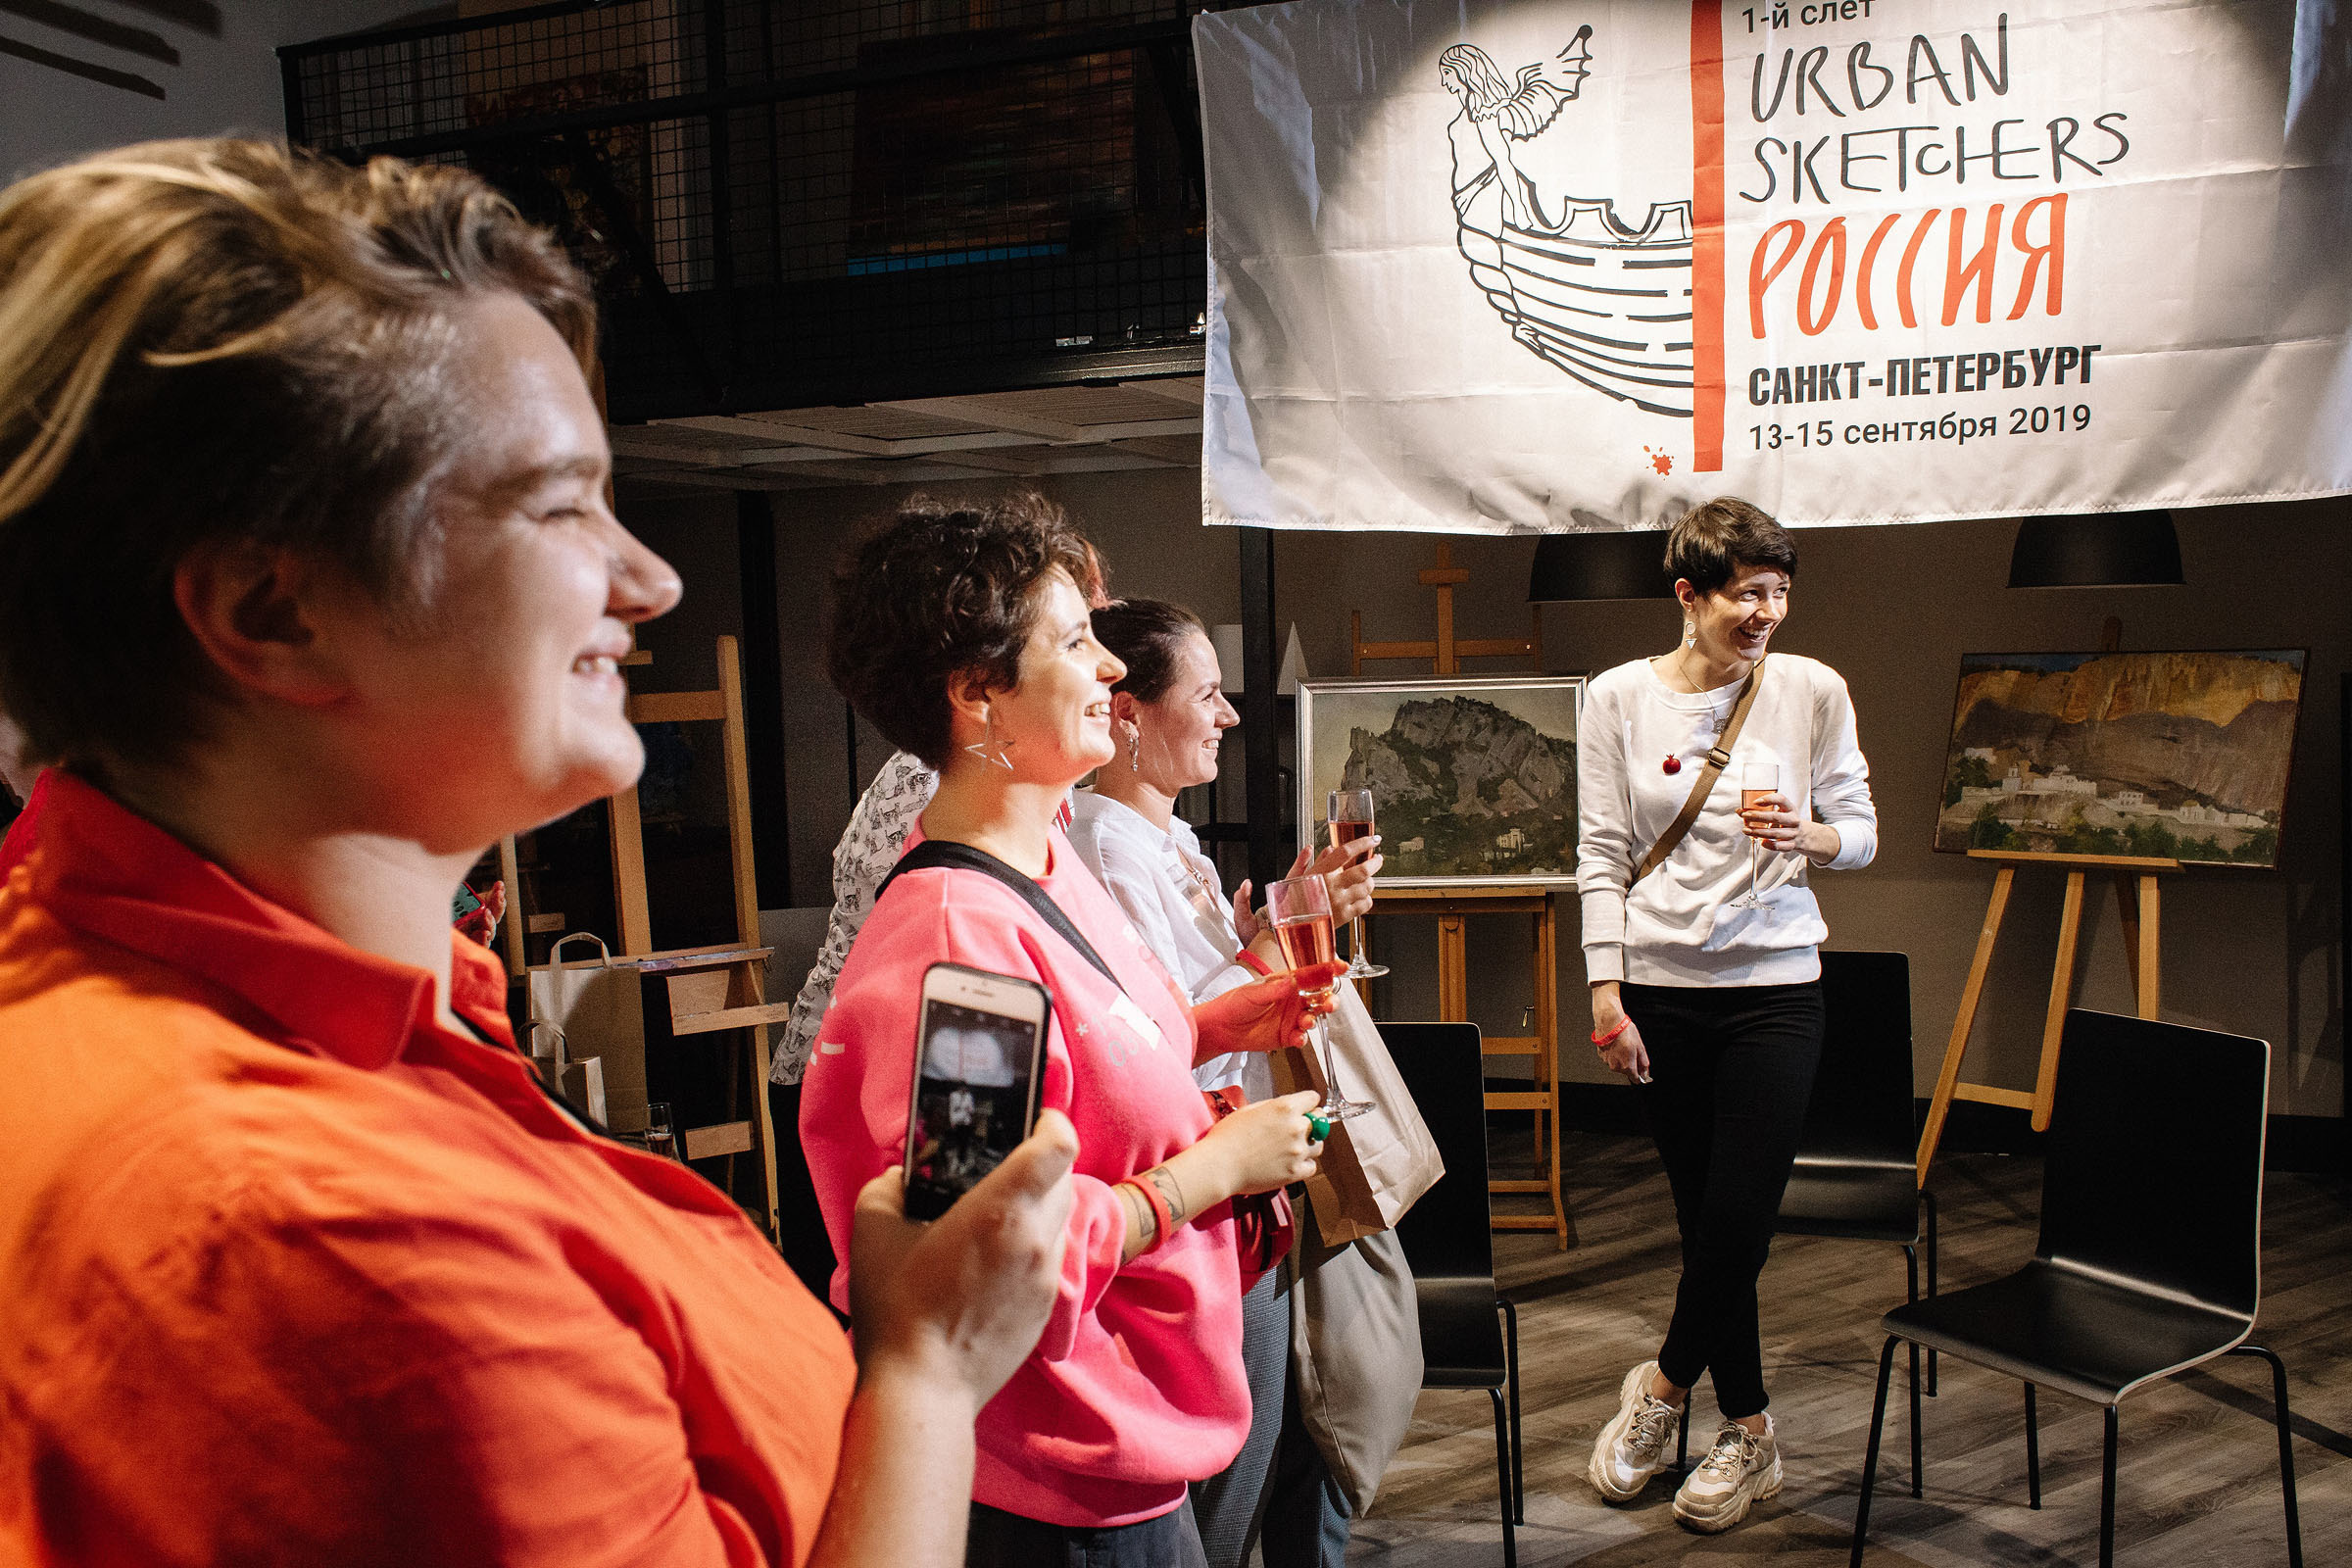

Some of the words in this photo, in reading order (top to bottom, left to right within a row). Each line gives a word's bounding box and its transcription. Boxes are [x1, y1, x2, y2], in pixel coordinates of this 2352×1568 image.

[1741, 2, 1789, 34] 1-й
[1800, 0, 1877, 25] слет
[1751, 12, 2009, 123] URBAN
[1739, 112, 2130, 205] SKETCHERS
[1748, 192, 2069, 340] РОССИЯ
[1748, 344, 2102, 407] САНКТ-ПЕТЕРБУРГ
[1749, 419, 1834, 450] 13-15
[1843, 411, 1997, 446] сентября
[2008, 404, 2091, 435] 2019
